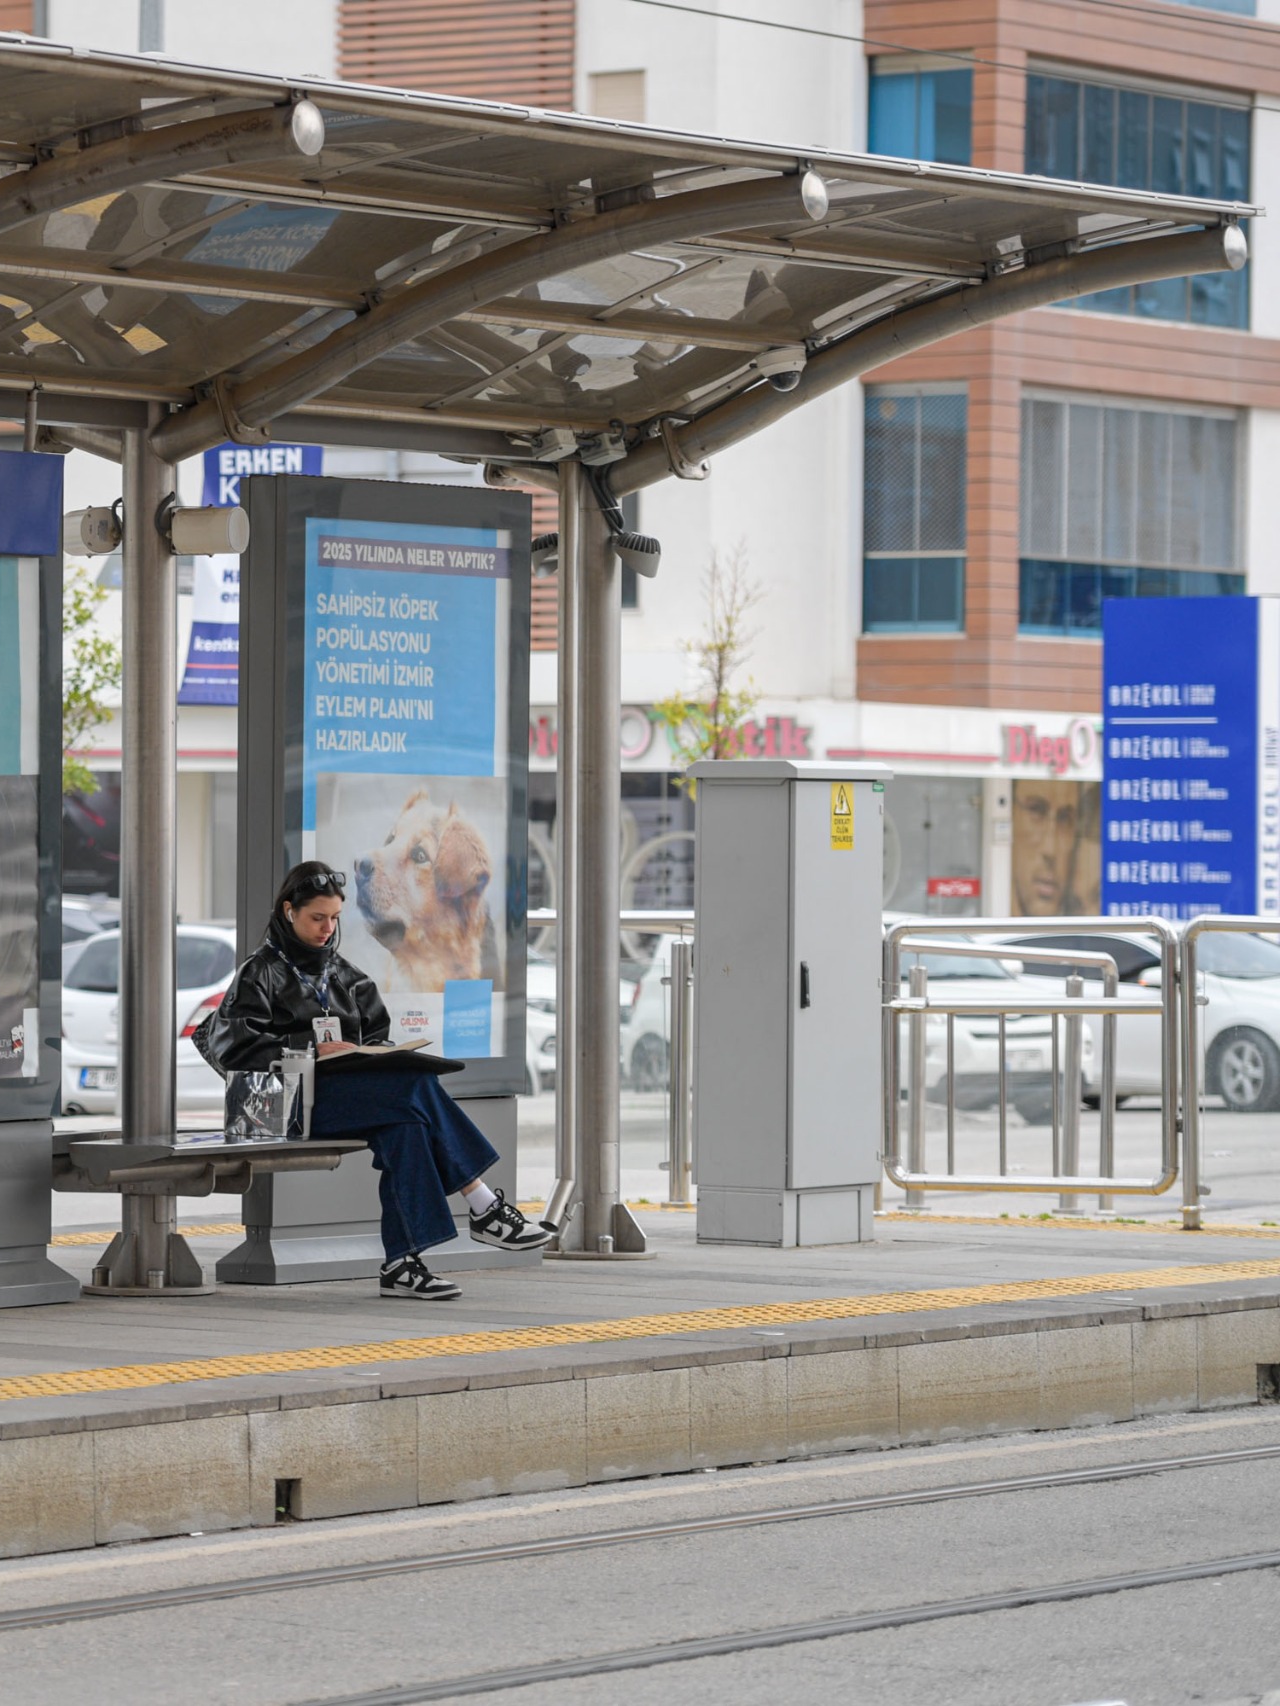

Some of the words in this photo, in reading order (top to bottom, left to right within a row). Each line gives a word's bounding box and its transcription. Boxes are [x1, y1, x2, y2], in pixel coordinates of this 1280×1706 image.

[219, 446, 302, 475] ERKEN
[322, 541, 352, 562] 2025
[354, 544, 404, 565] YILINDA
[407, 547, 445, 567] NELER
[447, 550, 496, 571] YAPTIK?
[316, 590, 386, 619] SAHİPSİZ
[390, 593, 439, 621] KÖPEK
[315, 624, 431, 654] POPÜLASYONU
[316, 657, 391, 686] YÖNETİMİ
[393, 658, 434, 688] İZMİR
[315, 695, 366, 719] EYLEM
[370, 698, 434, 721] PLANI'NI
[315, 728, 407, 753] HAZIRLADIK
